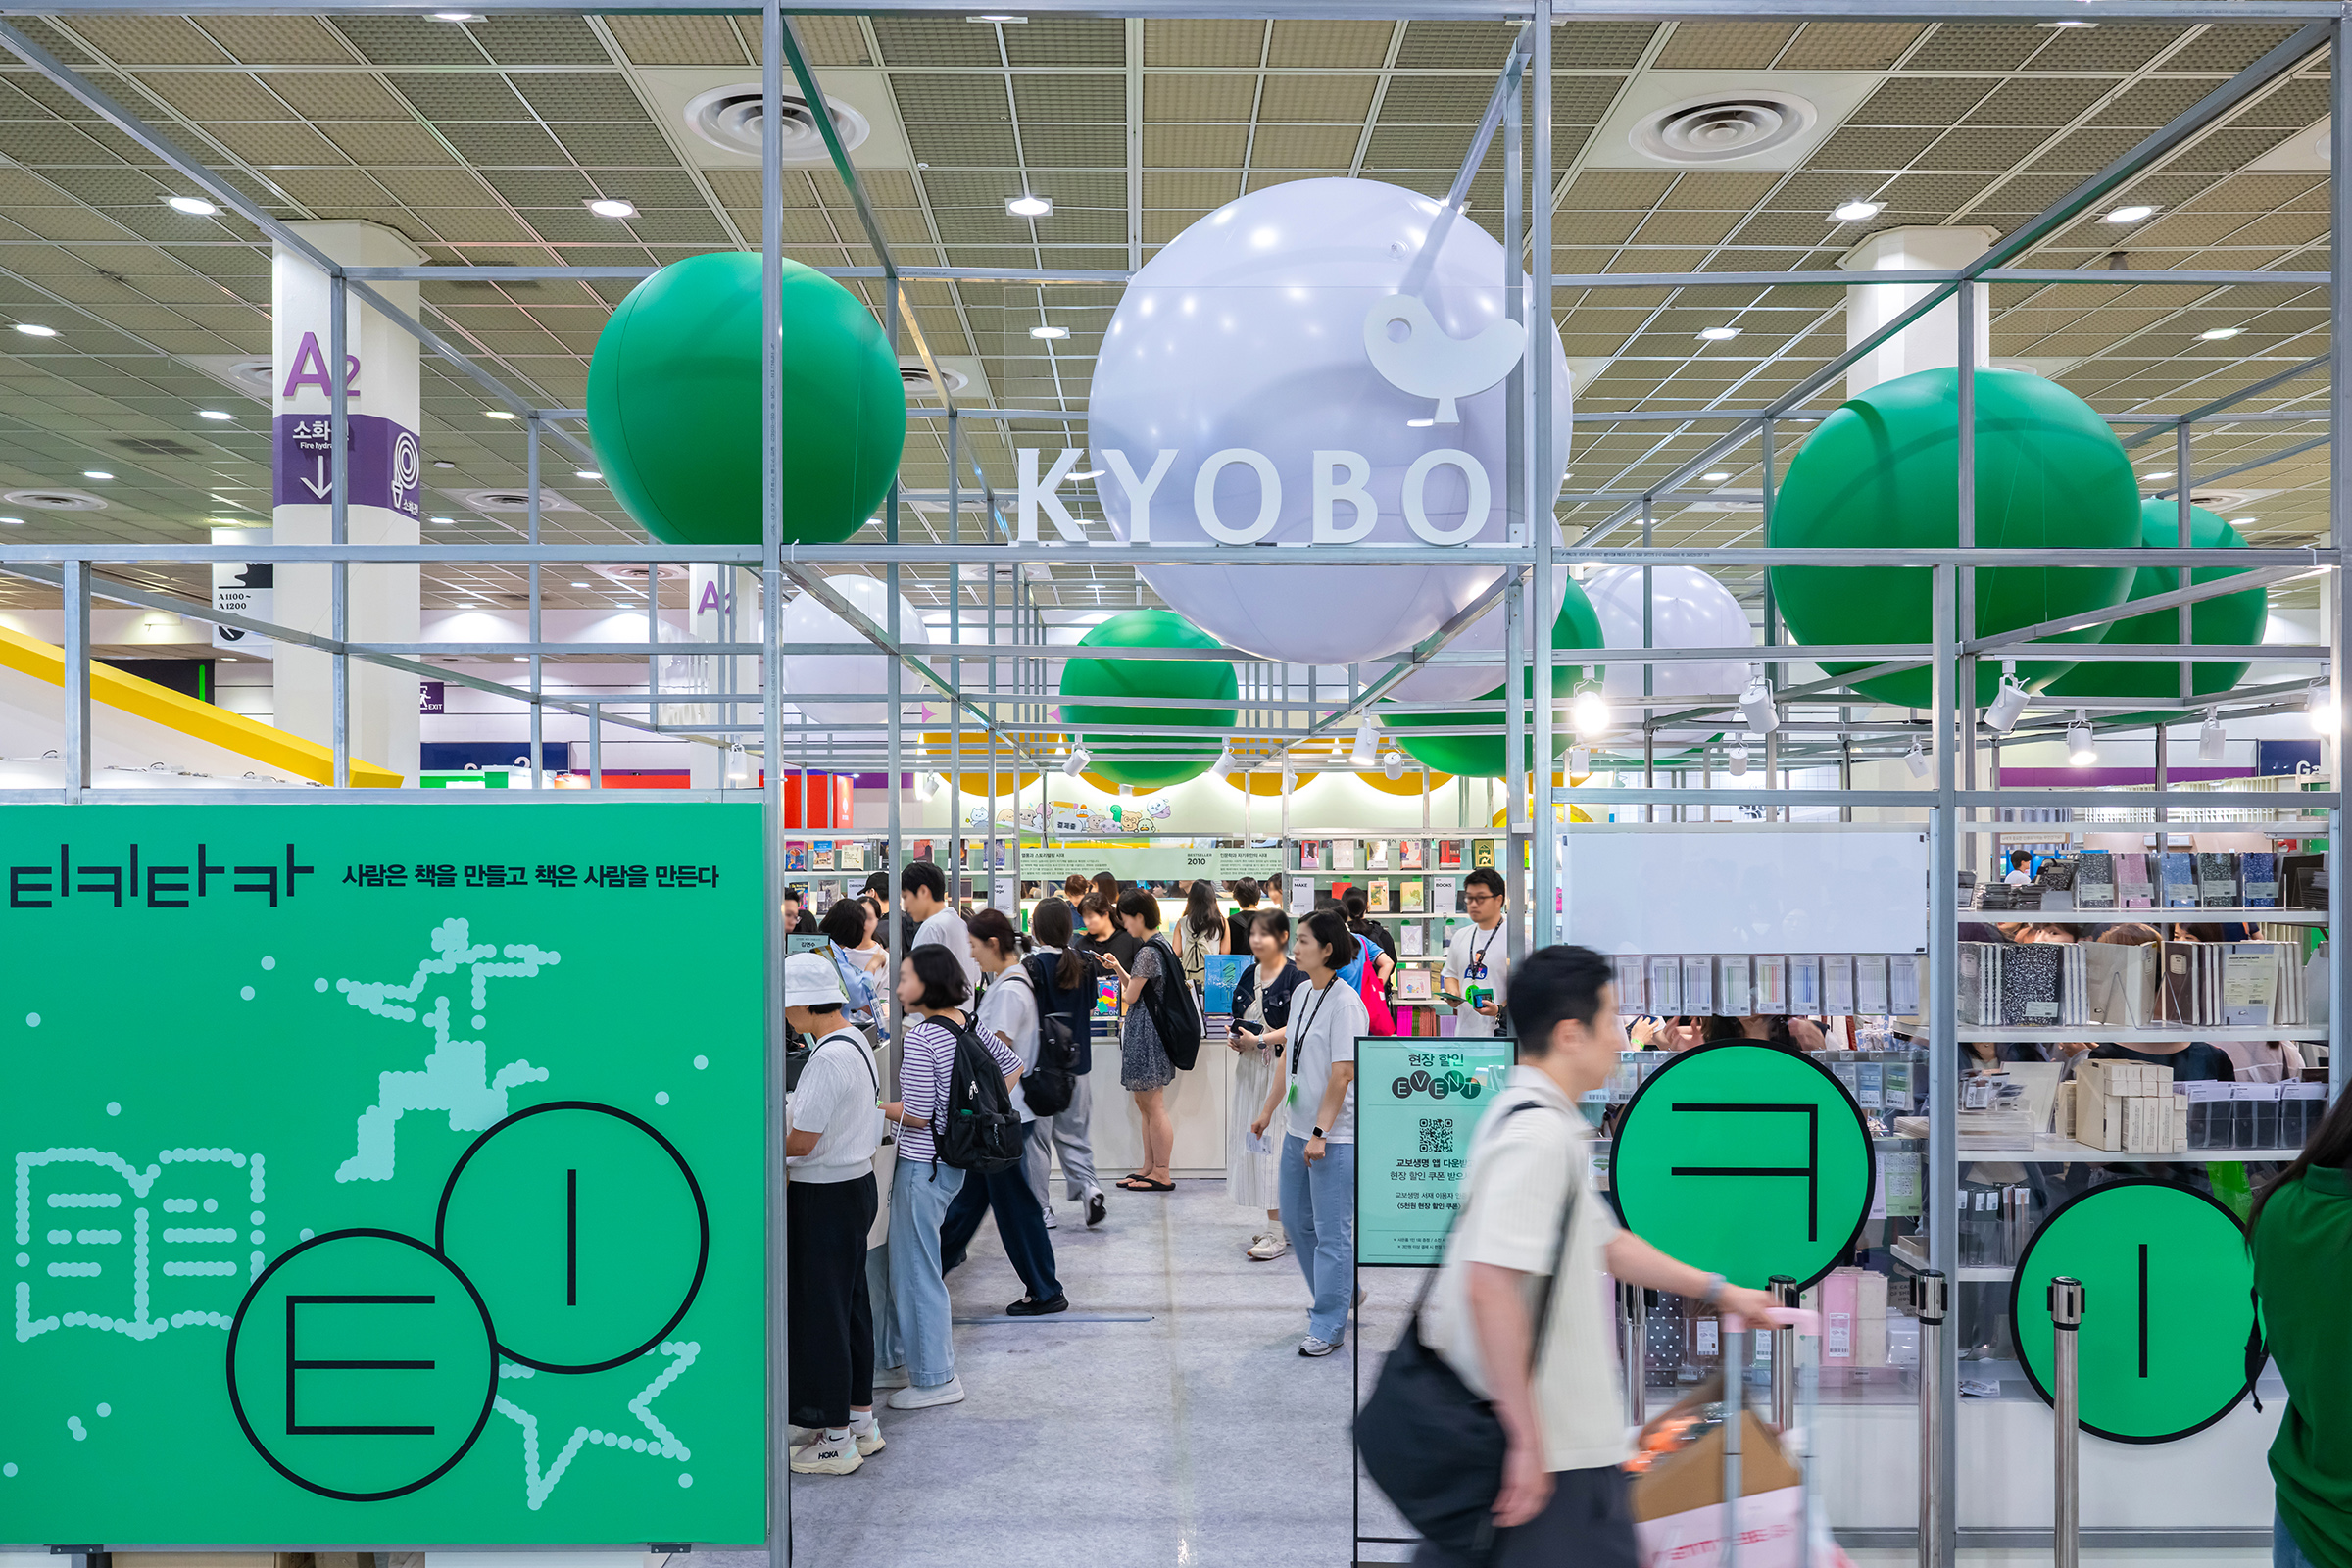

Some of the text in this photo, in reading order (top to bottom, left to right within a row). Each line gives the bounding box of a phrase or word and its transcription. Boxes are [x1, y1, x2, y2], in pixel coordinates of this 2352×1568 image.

[292, 420, 350, 441] 소화
[1017, 448, 1491, 546] KYOBO
[402, 498, 419, 517] 소화전
[428, 702, 443, 710] EXIT
[10, 844, 314, 907] 티키타카
[342, 864, 719, 887] 사람은 책을 만들고 책은 사람을 만든다
[1408, 1054, 1464, 1067] 현장 할인
[1396, 1072, 1478, 1097] EVENT
[1396, 1158, 1429, 1168] 교보생명
[1432, 1158, 1441, 1168] 앱
[1390, 1171, 1406, 1181] 현장
[1409, 1171, 1426, 1181] 할인
[1428, 1171, 1446, 1181] 쿠폰
[818, 1450, 839, 1460] HOKA
